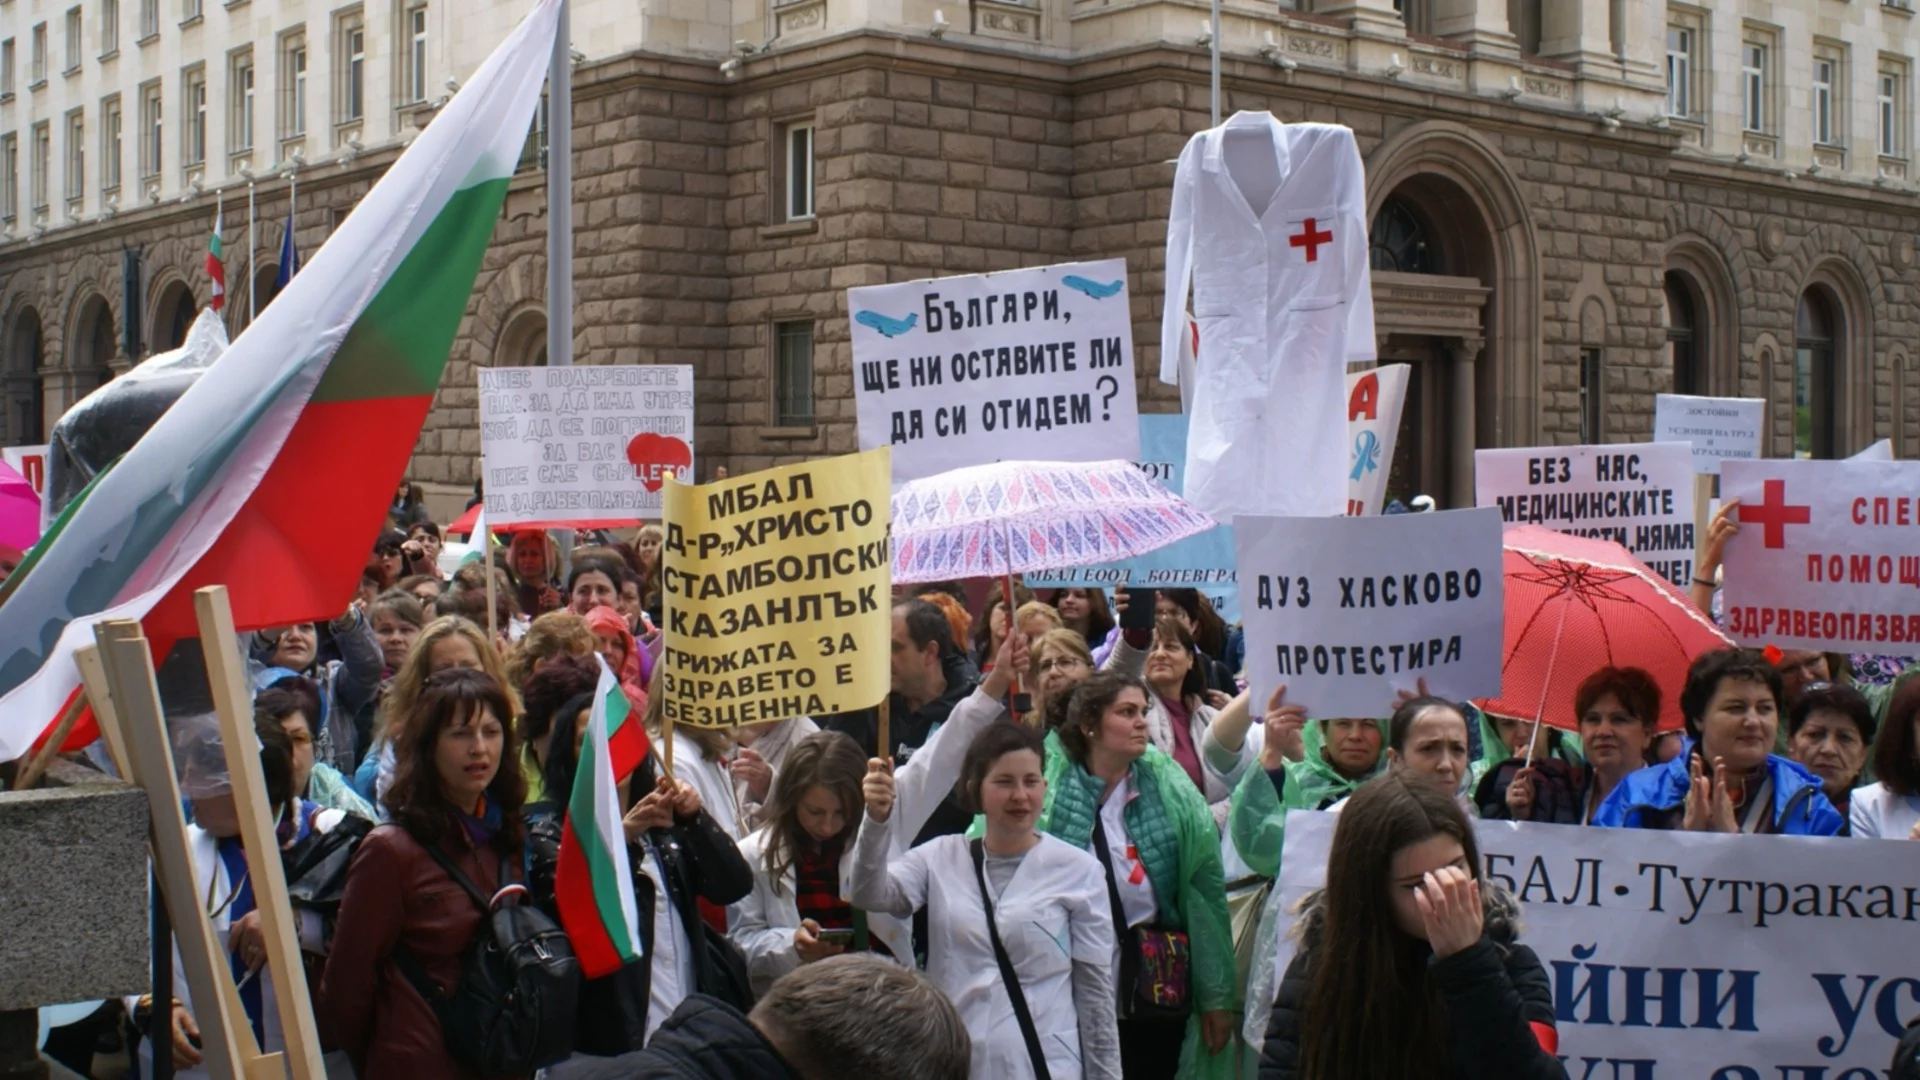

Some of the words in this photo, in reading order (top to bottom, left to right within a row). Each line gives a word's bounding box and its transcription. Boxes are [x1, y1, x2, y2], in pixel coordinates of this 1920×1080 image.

[481, 369, 532, 394] ДНЕС
[546, 367, 679, 391] ПОДКРЕПЕТЕ
[862, 359, 900, 394] ЩЕ
[910, 355, 942, 387] НИ
[951, 341, 1077, 382] ОСТАВИТЕ
[1089, 337, 1123, 369] ЛИ
[556, 392, 589, 416] ДА
[593, 391, 636, 411] ИМА
[482, 415, 518, 441] КОЙ
[523, 418, 553, 443] ДА
[559, 417, 585, 437] СЕ
[591, 415, 686, 435] ПОГРИЖИ
[891, 409, 923, 445] ДА
[935, 405, 966, 437] СИ
[543, 442, 567, 461] ЗА
[491, 466, 529, 488] НИЕ
[537, 464, 579, 484] СМЕ
[592, 463, 688, 483] СЪРЦЕТО
[1528, 457, 1572, 485] БЕЗ
[484, 494, 508, 513] НА
[708, 472, 814, 521] МБАЛ
[1497, 488, 1674, 525] МЕДИЦИНСКИТЕ
[1852, 497, 1920, 525] СПЕ
[1027, 568, 1077, 582] МБАЛ
[1138, 568, 1238, 584] „БОТЕВГРА
[1257, 574, 1311, 610] ДУЗ
[1338, 567, 1482, 609] ХАСКОВО
[671, 584, 878, 639] КАЗАНЛЪК
[665, 641, 796, 675] ГРИЖАТА
[817, 632, 858, 657] ЗА
[1276, 635, 1462, 676] ПРОТЕСТИРА
[664, 667, 816, 703] ЗДРАВЕТО
[835, 663, 853, 685] Е
